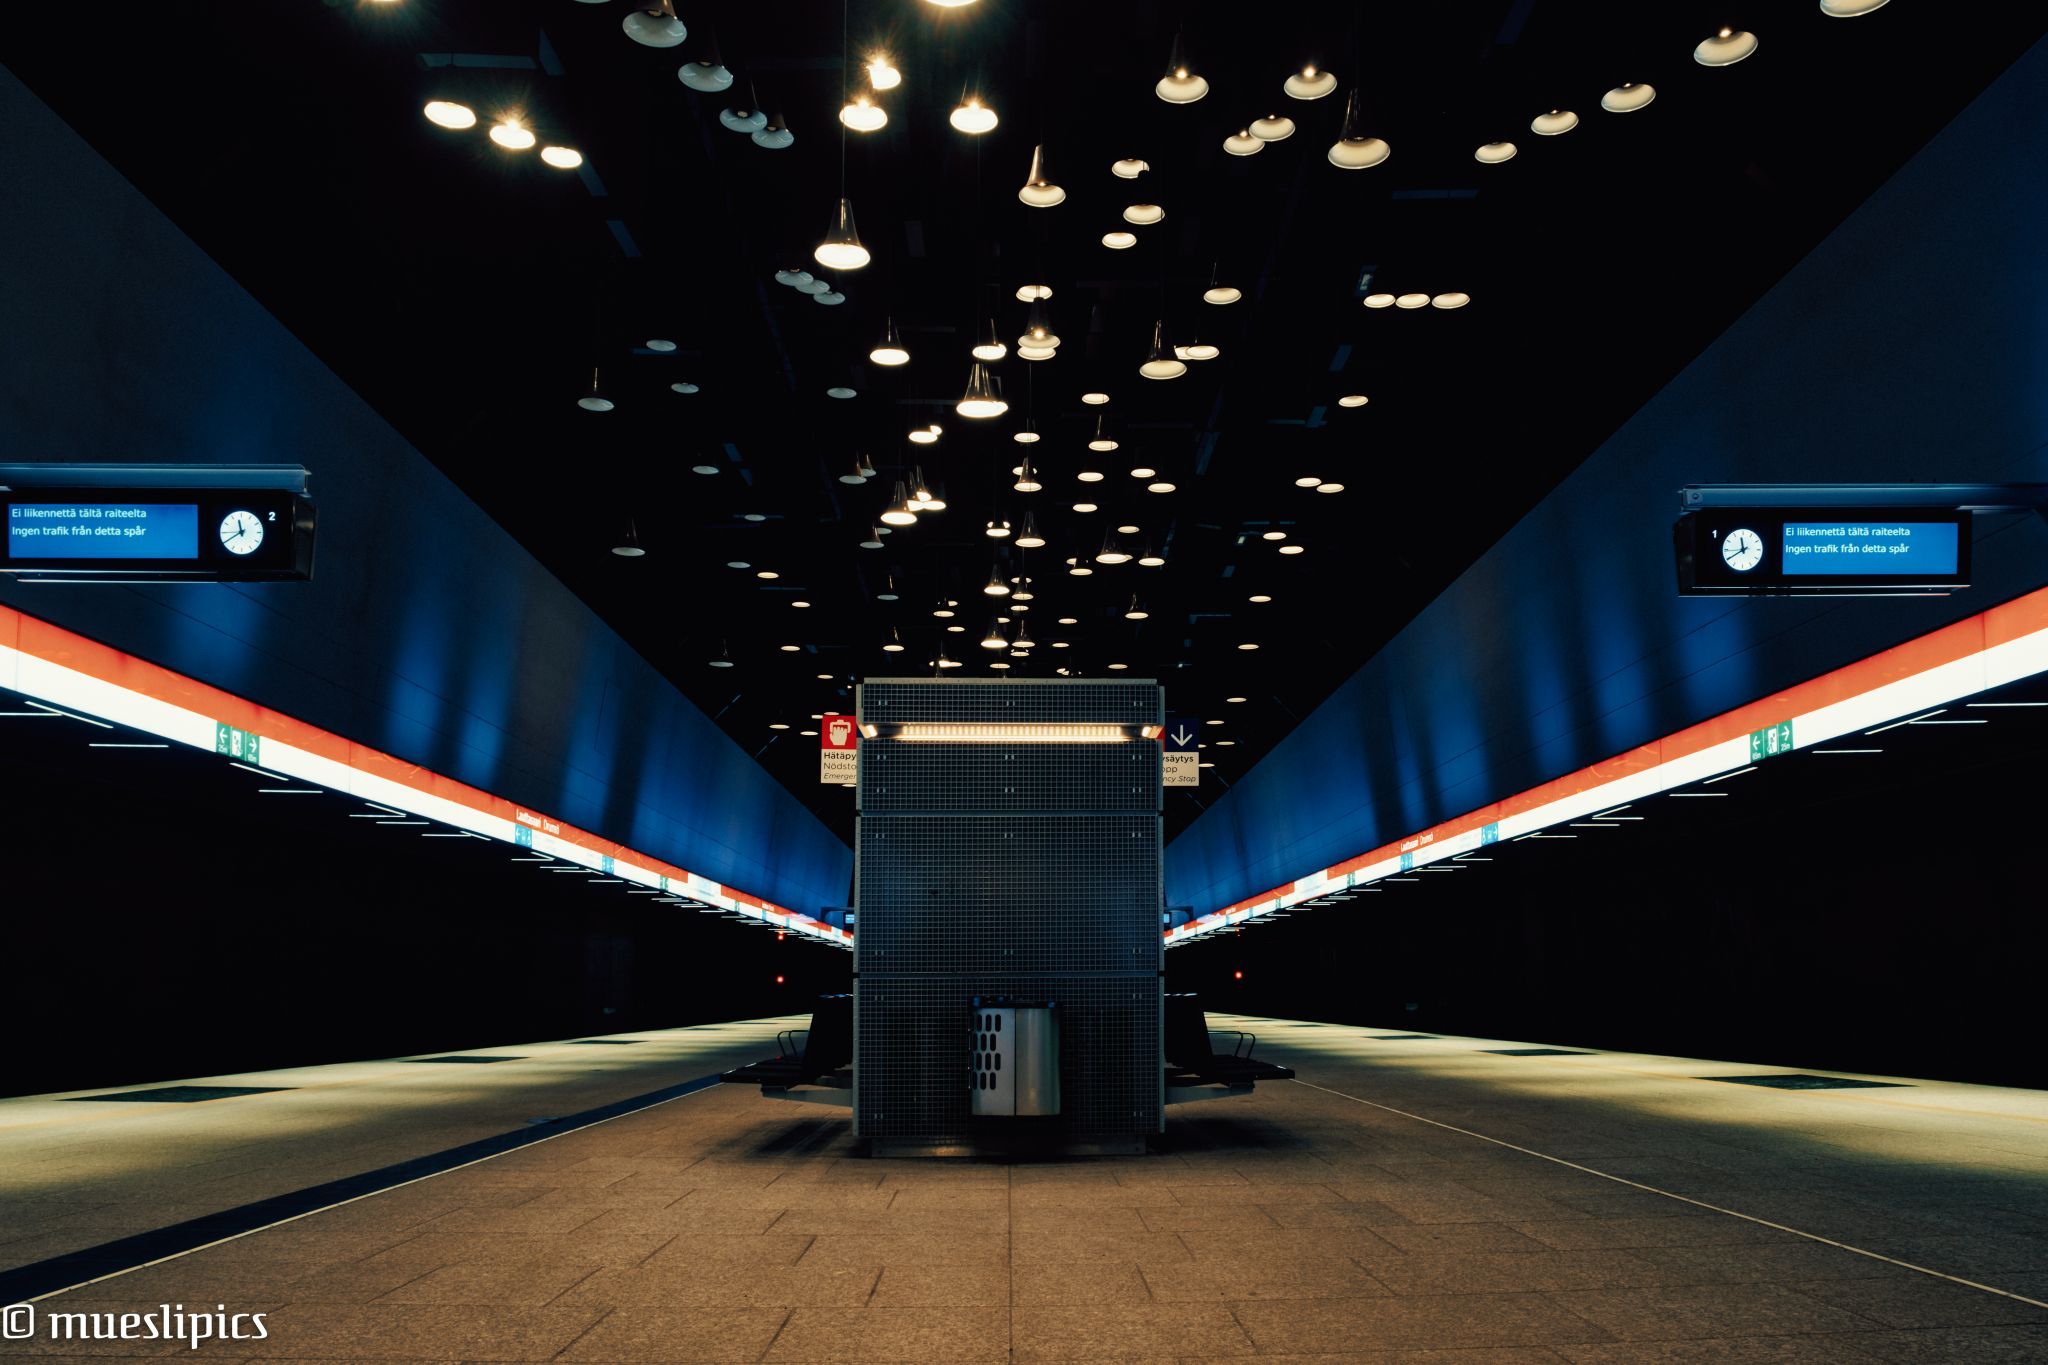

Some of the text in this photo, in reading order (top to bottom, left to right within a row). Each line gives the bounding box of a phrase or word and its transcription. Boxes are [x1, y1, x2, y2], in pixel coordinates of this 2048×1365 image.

[12, 508, 147, 518] Ei liikennettä tältä raiteelta
[267, 511, 276, 521] 2
[12, 525, 146, 538] Ingen trafik från detta spår
[1711, 529, 1718, 538] 1
[1785, 527, 1911, 536] Ei liikennettä tältä raiteelta
[1785, 543, 1910, 555] Ingen trafik från detta spår
